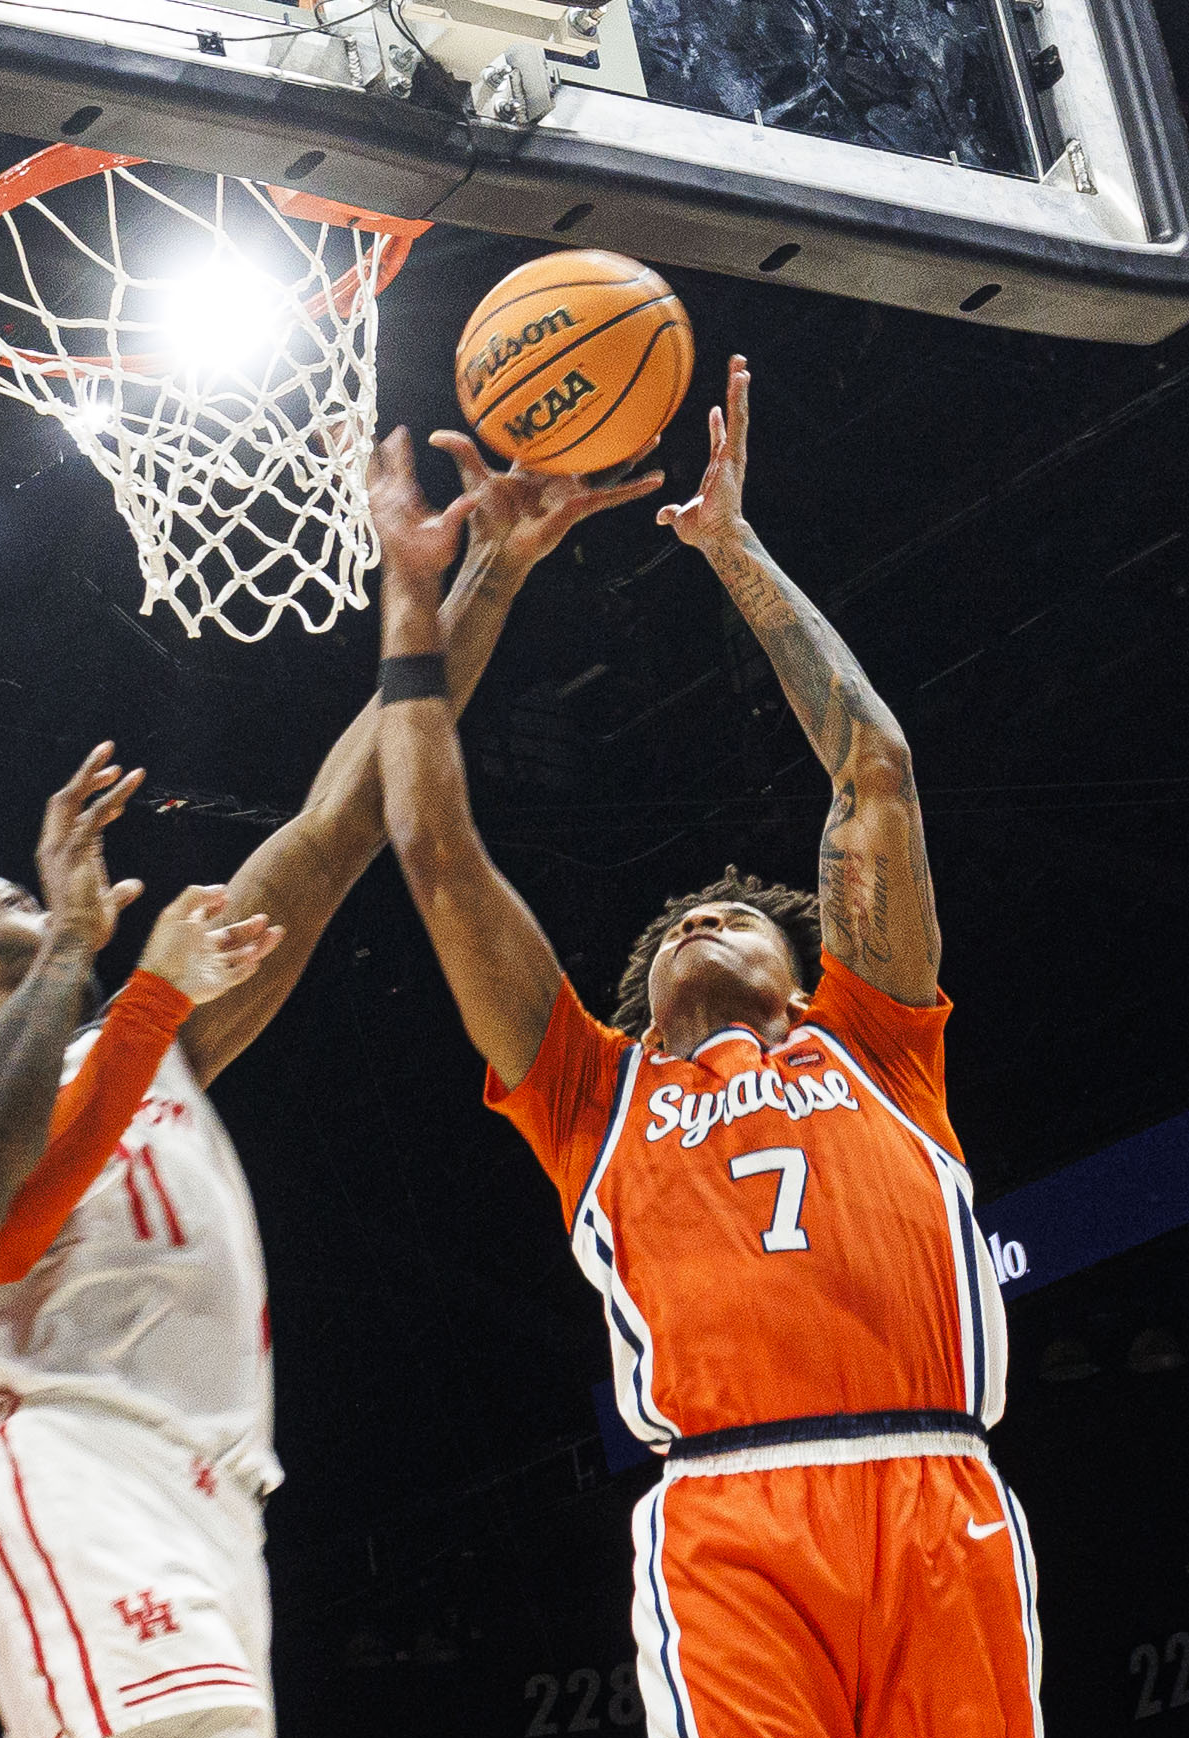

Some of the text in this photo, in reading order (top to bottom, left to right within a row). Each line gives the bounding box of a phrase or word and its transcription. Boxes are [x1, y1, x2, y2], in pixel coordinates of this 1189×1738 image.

[503, 369, 598, 447] NCAA
[645, 1069, 859, 1148] Syracuse
[729, 1147, 810, 1253] 7
[524, 1661, 645, 1738] 228
